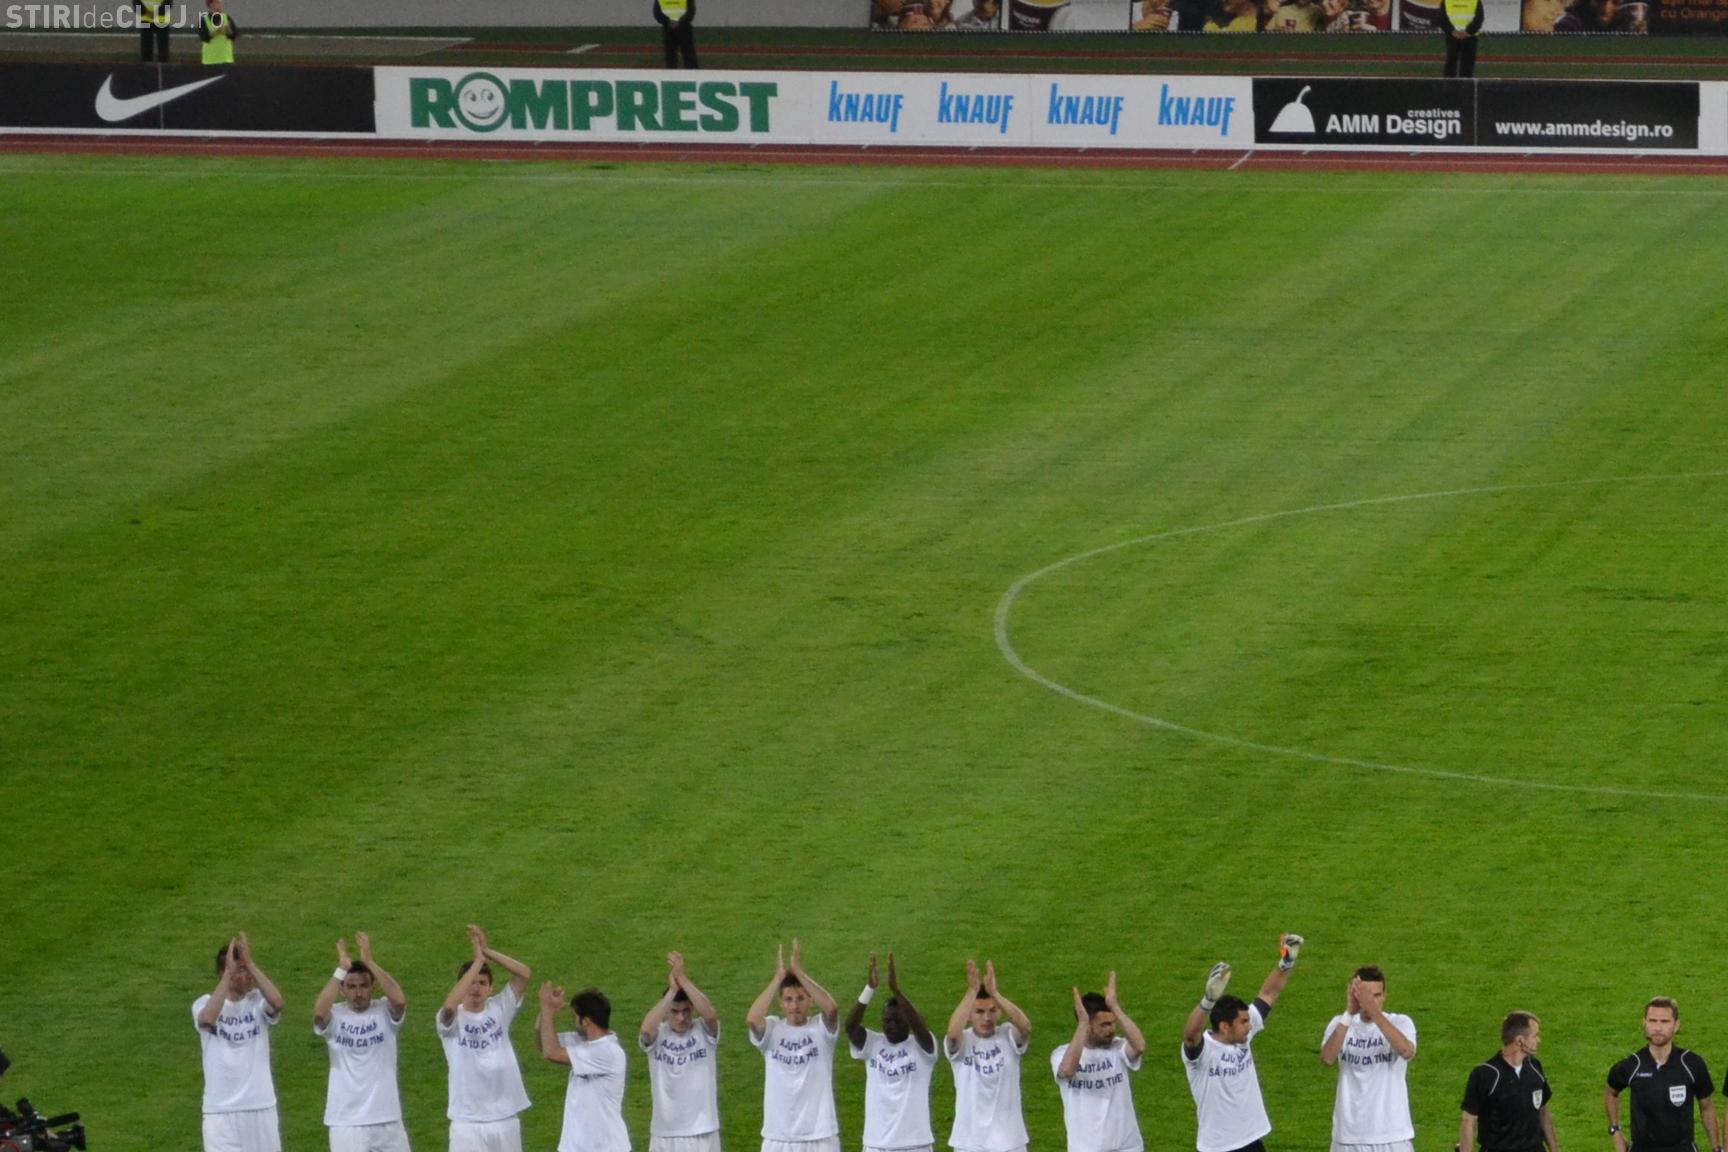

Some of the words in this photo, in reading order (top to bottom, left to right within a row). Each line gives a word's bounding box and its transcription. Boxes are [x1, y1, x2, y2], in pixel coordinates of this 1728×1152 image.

[1680, 8, 1728, 22] Orange
[409, 71, 778, 133] ROMPREST
[1407, 108, 1461, 118] creatives
[1325, 115, 1380, 134] AMM
[1386, 114, 1462, 139] Design
[1495, 120, 1674, 141] www.ammdesign.ro
